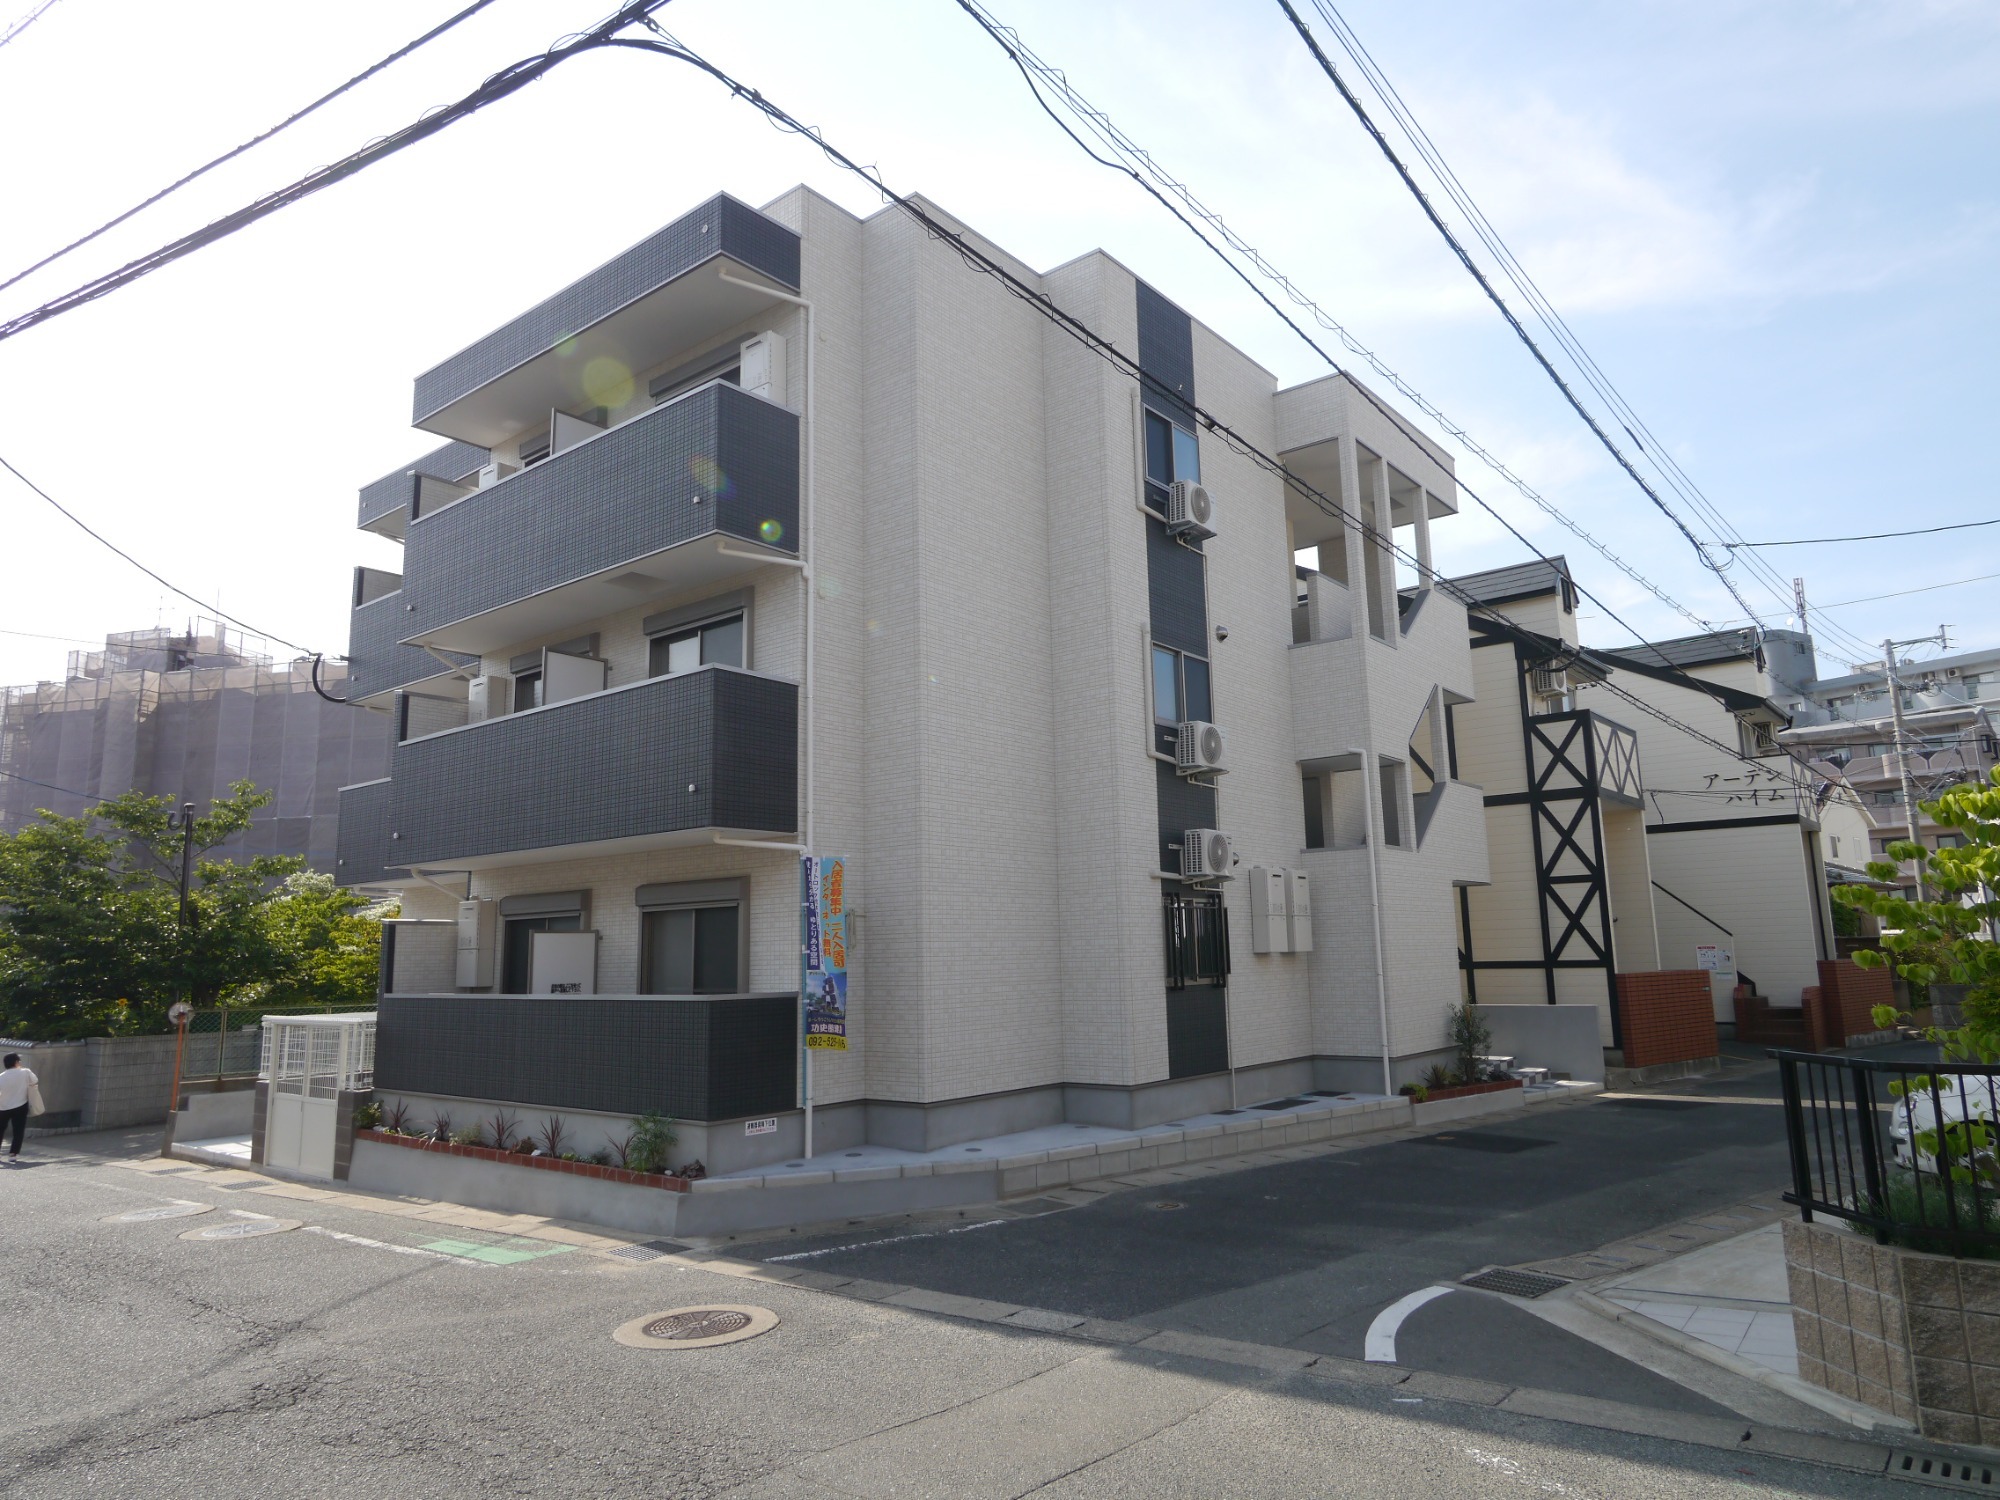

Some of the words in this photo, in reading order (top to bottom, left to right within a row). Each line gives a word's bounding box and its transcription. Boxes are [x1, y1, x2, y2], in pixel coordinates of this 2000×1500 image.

[1726, 789, 1784, 806] ハイム
[830, 860, 844, 916] 入居者募集中
